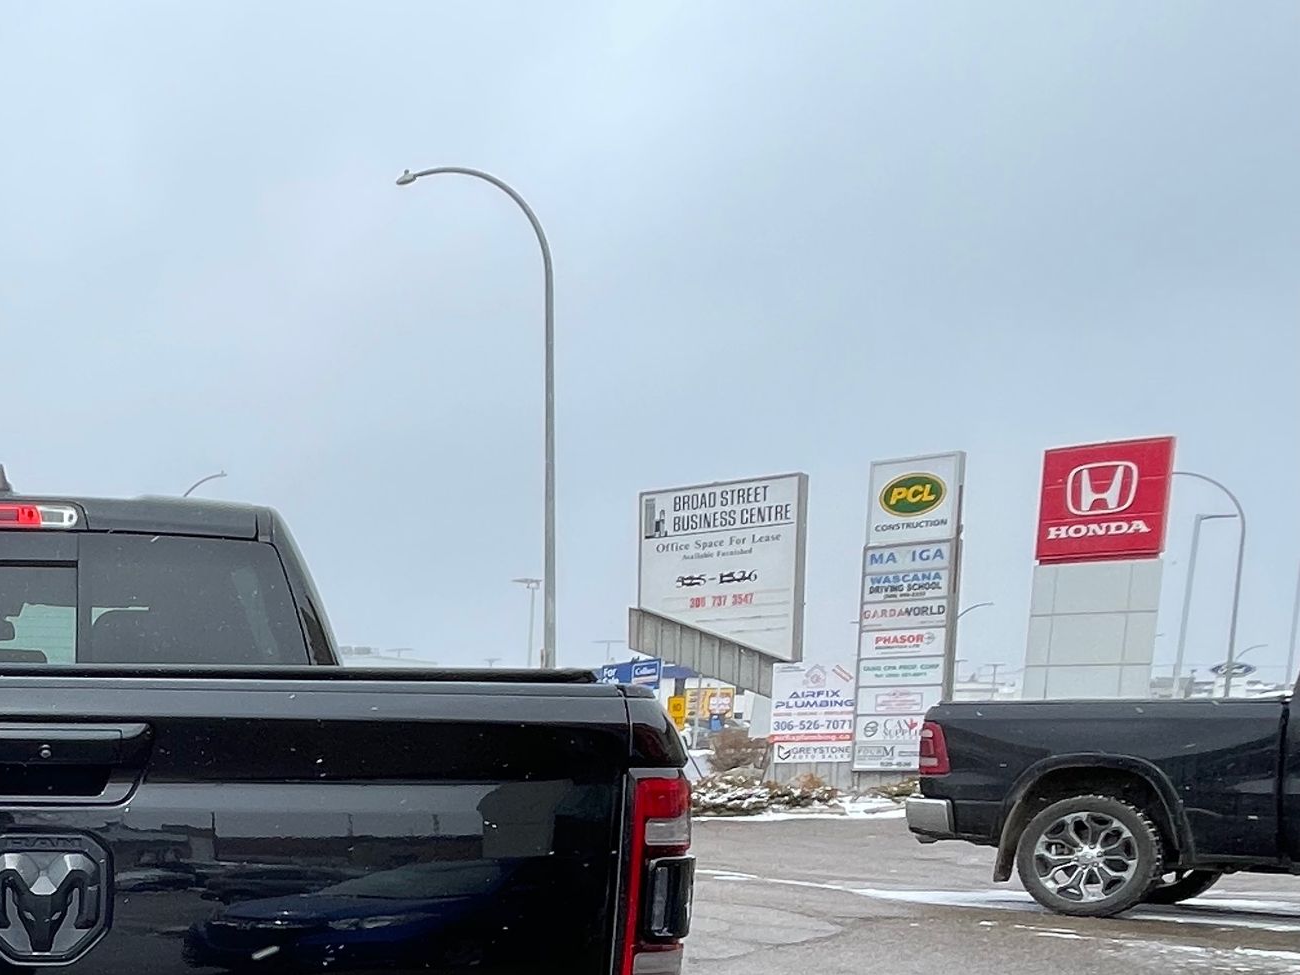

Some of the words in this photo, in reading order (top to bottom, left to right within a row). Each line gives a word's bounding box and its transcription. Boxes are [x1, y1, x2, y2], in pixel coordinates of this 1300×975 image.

[673, 491, 716, 512] BROAD
[720, 485, 769, 507] STREET
[889, 483, 936, 506] PCL
[673, 510, 736, 532] BUSINESS
[740, 503, 791, 525] CENTRE
[874, 518, 948, 532] CONSTRUCTION
[1046, 520, 1151, 540] HONDA
[656, 541, 690, 554] Office
[694, 538, 725, 551] Space
[729, 535, 746, 546] For
[752, 532, 782, 544] Lease
[870, 572, 943, 585] WASCANA
[869, 583, 904, 595] DRIVING
[907, 581, 942, 592] SCHOOL
[712, 595, 727, 607] 737
[731, 592, 755, 606] 3547
[875, 634, 925, 645] PHASOR
[603, 667, 617, 677] For
[789, 689, 841, 699] AIRFIX
[775, 699, 855, 709] PLUMBING
[773, 719, 852, 731] 306-526-7071
[792, 745, 851, 754] GREYSTONE
